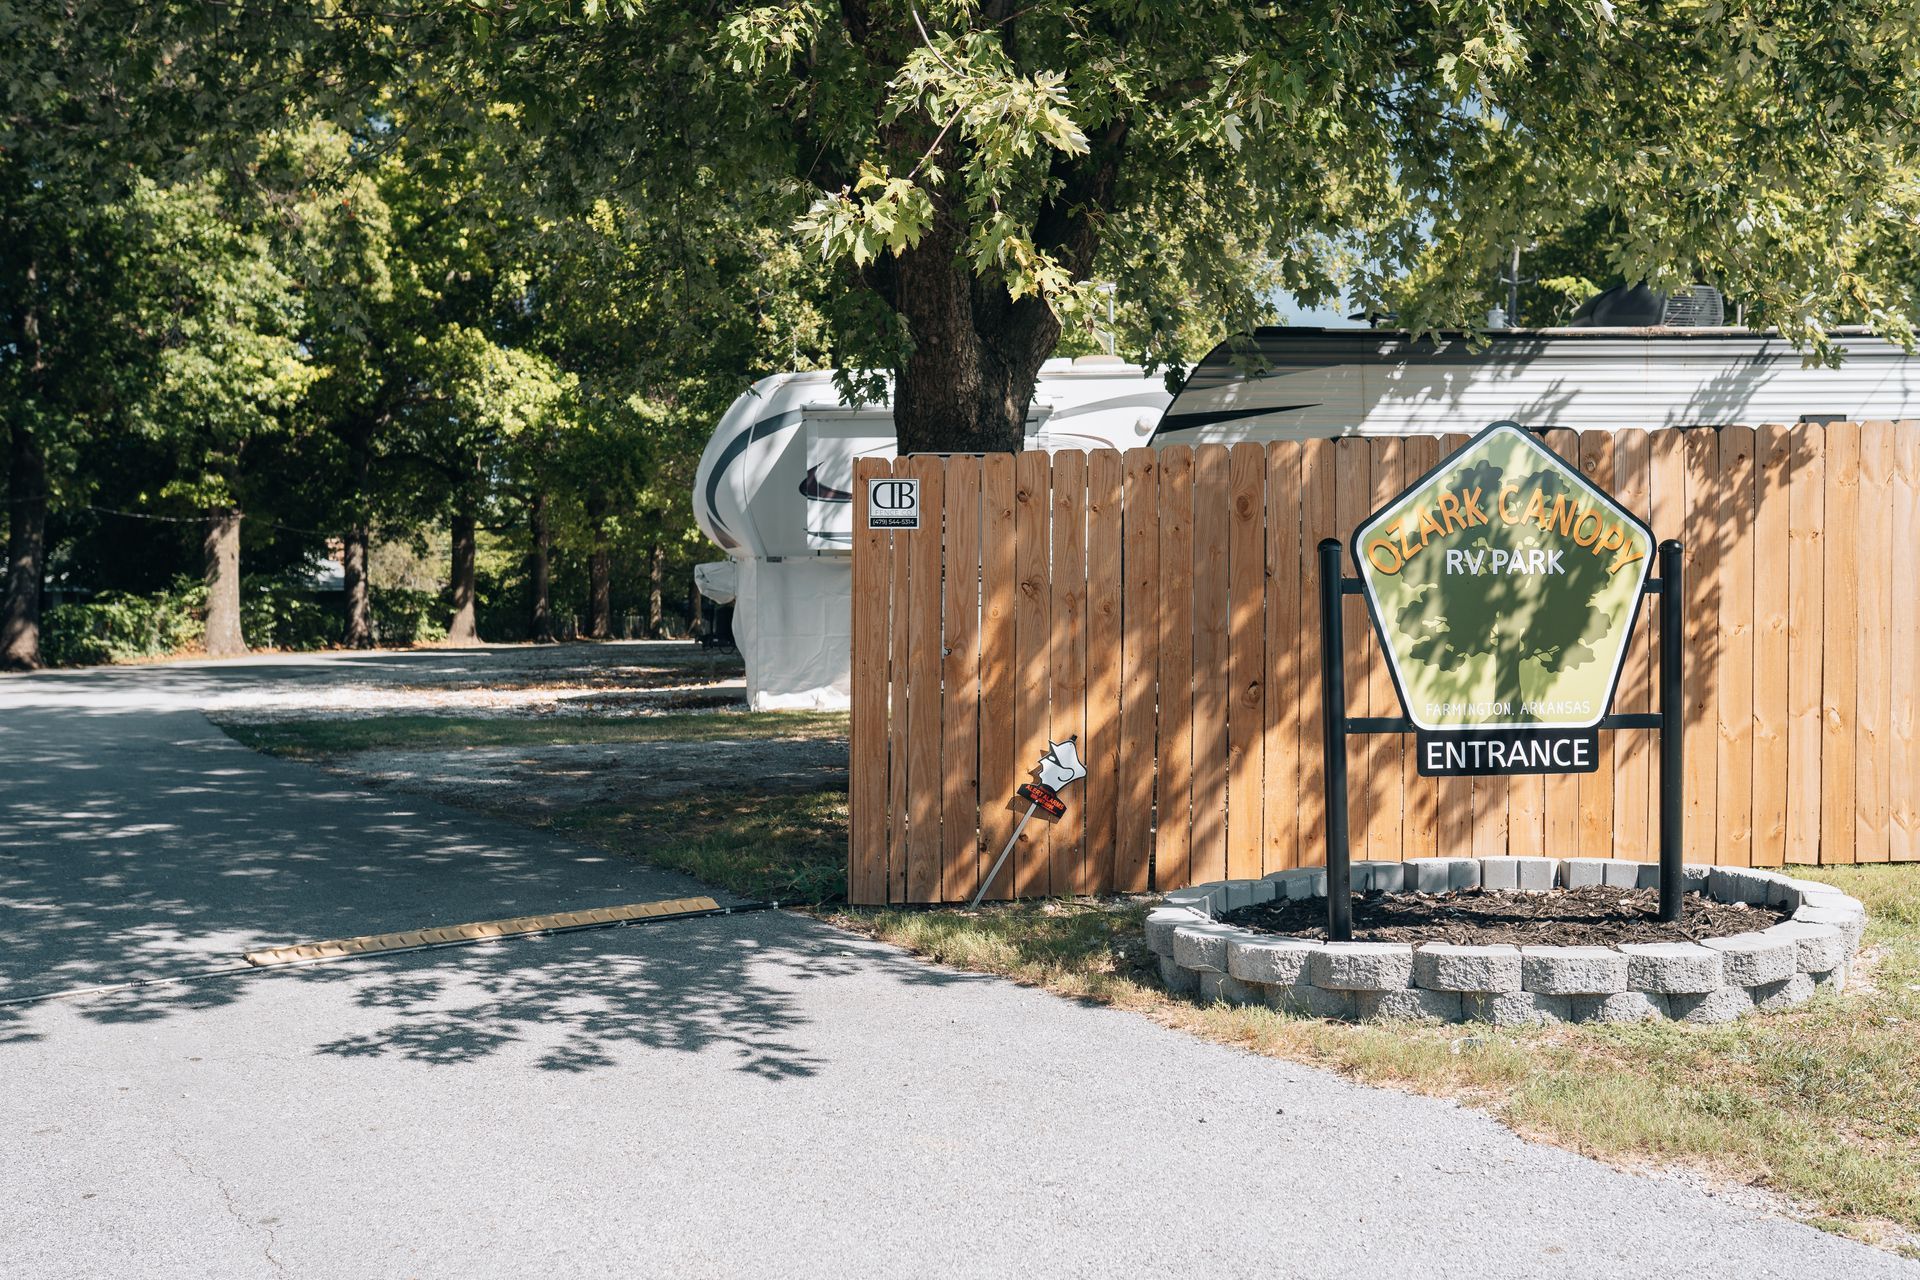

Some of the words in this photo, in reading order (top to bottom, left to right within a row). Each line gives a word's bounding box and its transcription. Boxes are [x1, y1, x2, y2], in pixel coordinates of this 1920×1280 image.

[1368, 486, 1489, 575] OZARK
[1498, 484, 1644, 574] CANOPY
[1446, 549, 1485, 575] RV
[1492, 549, 1566, 575] PARK
[1520, 700, 1591, 715] ARKANSAS
[1427, 739, 1590, 769] ENTRANCE
[1025, 784, 1043, 796] ALERT
[1043, 795, 1064, 810] ALARMS
